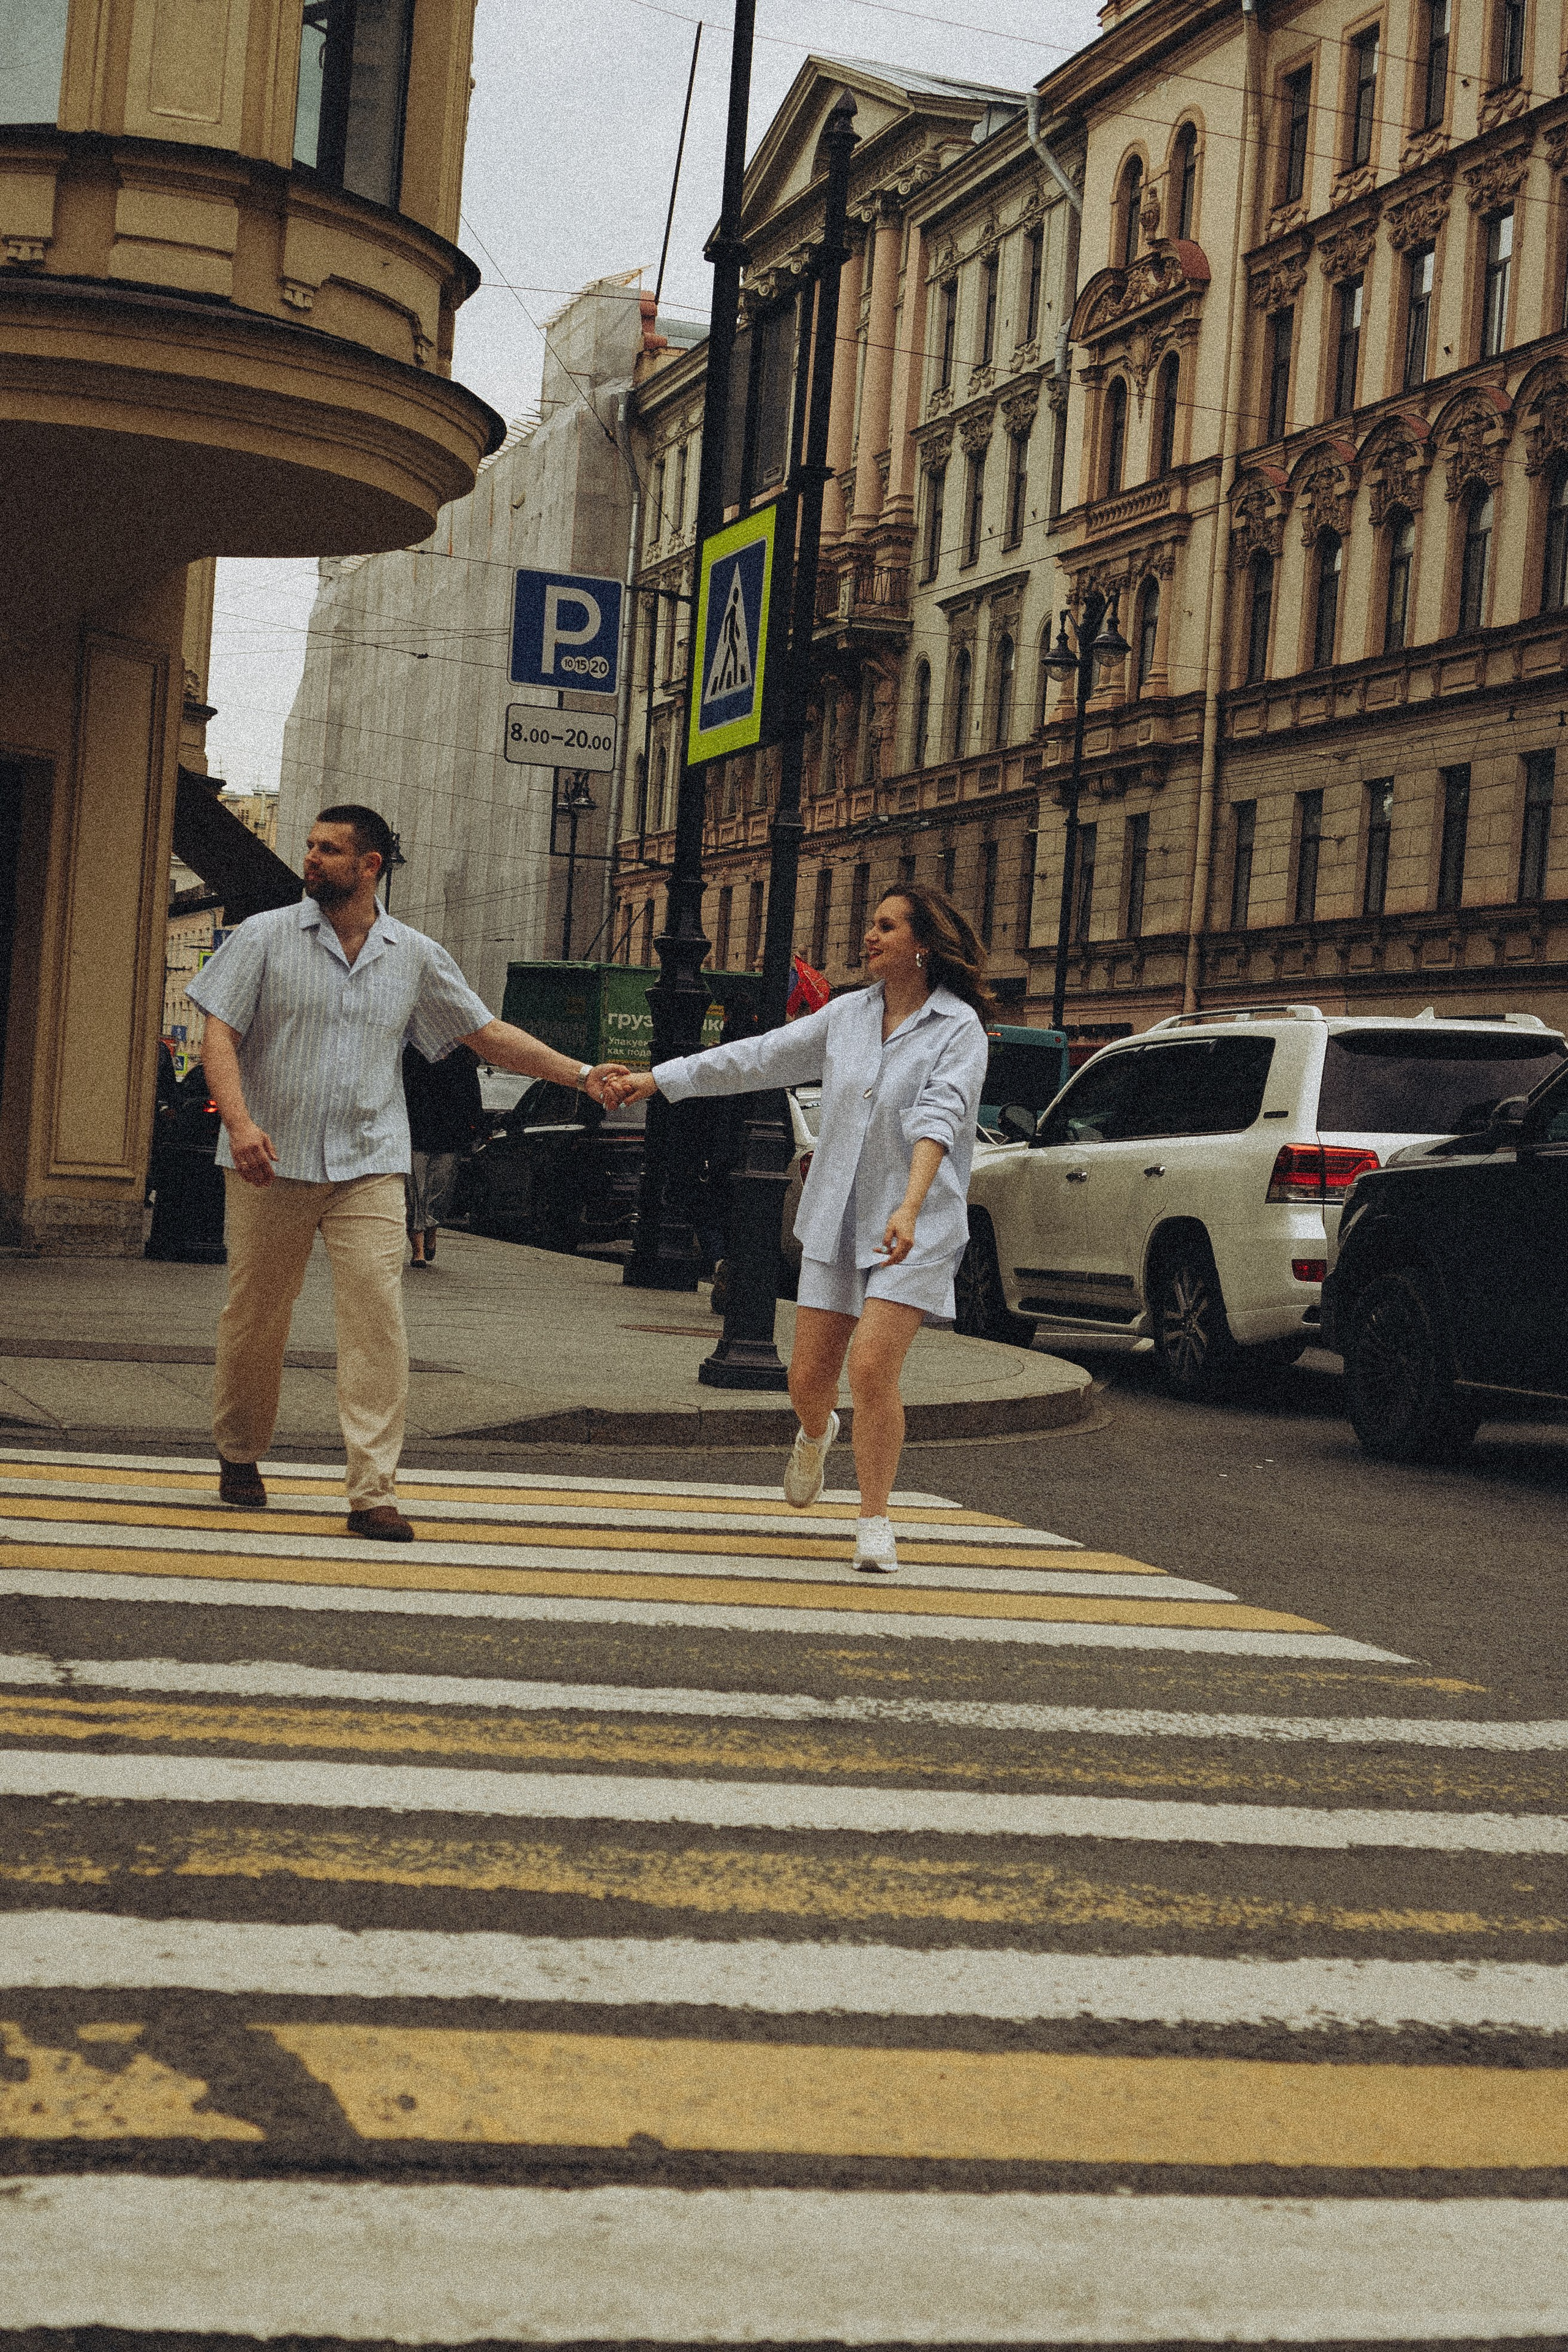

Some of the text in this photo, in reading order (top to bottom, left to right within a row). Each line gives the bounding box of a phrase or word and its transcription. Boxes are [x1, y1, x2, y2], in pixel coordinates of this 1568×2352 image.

[541, 585, 601, 674] P
[564, 658, 607, 674] 10 15 20
